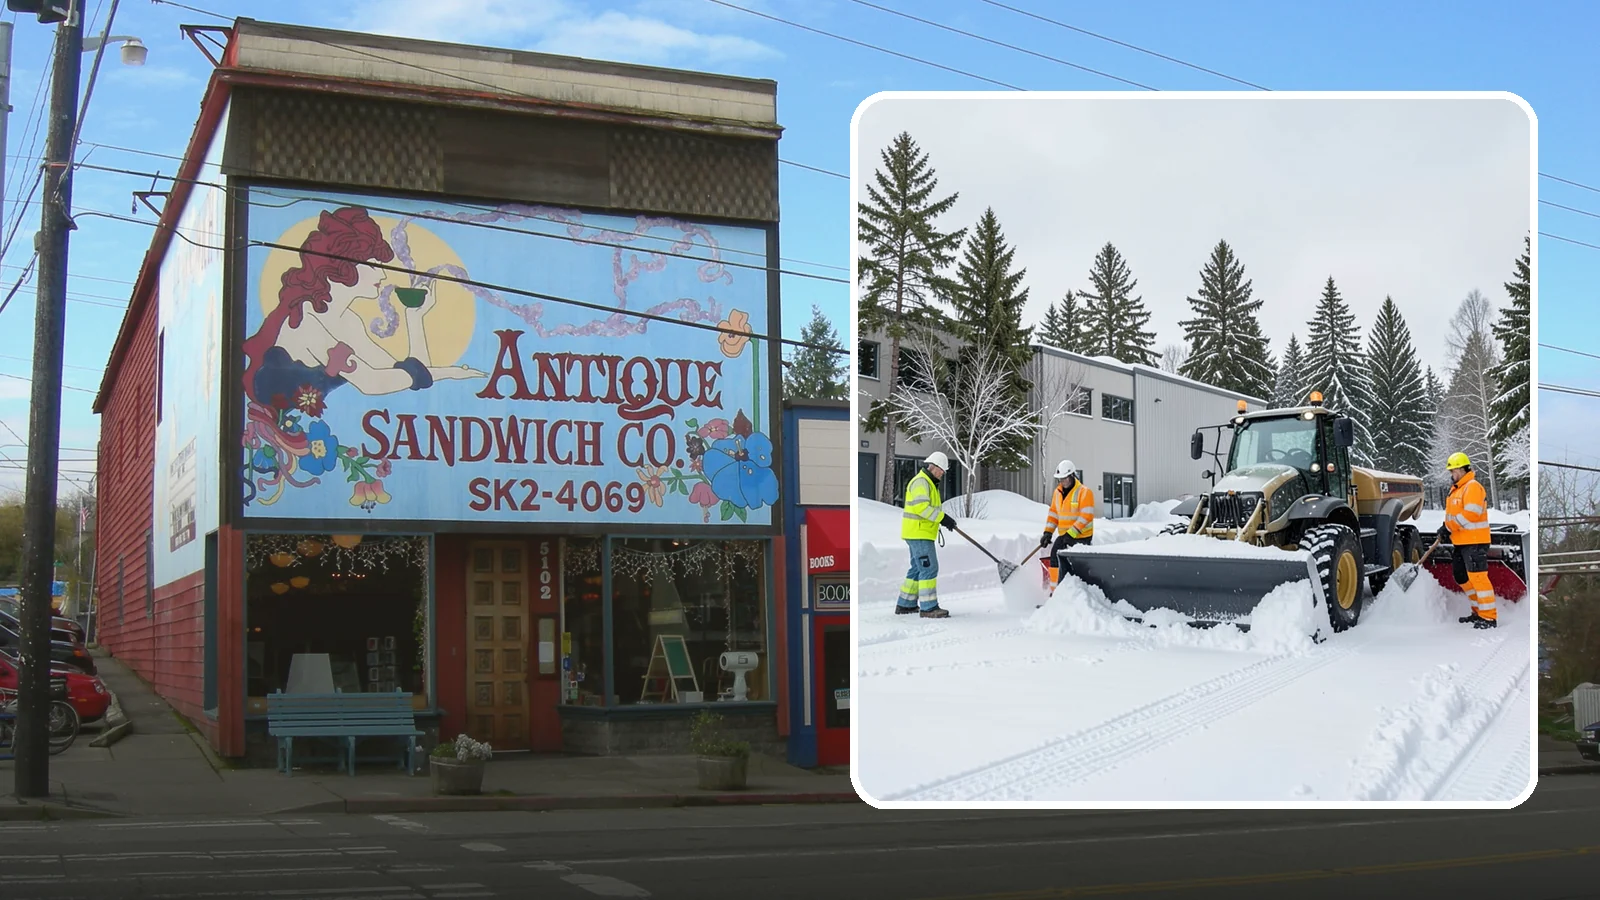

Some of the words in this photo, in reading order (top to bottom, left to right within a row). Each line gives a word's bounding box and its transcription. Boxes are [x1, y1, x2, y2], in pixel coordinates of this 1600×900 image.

[475, 329, 723, 421] ANTIQUE
[361, 407, 605, 467] SANDWICH
[616, 421, 685, 468] CO.
[467, 476, 646, 514] SK2-4069
[540, 541, 551, 600] 5102
[809, 555, 835, 569] BOOKS
